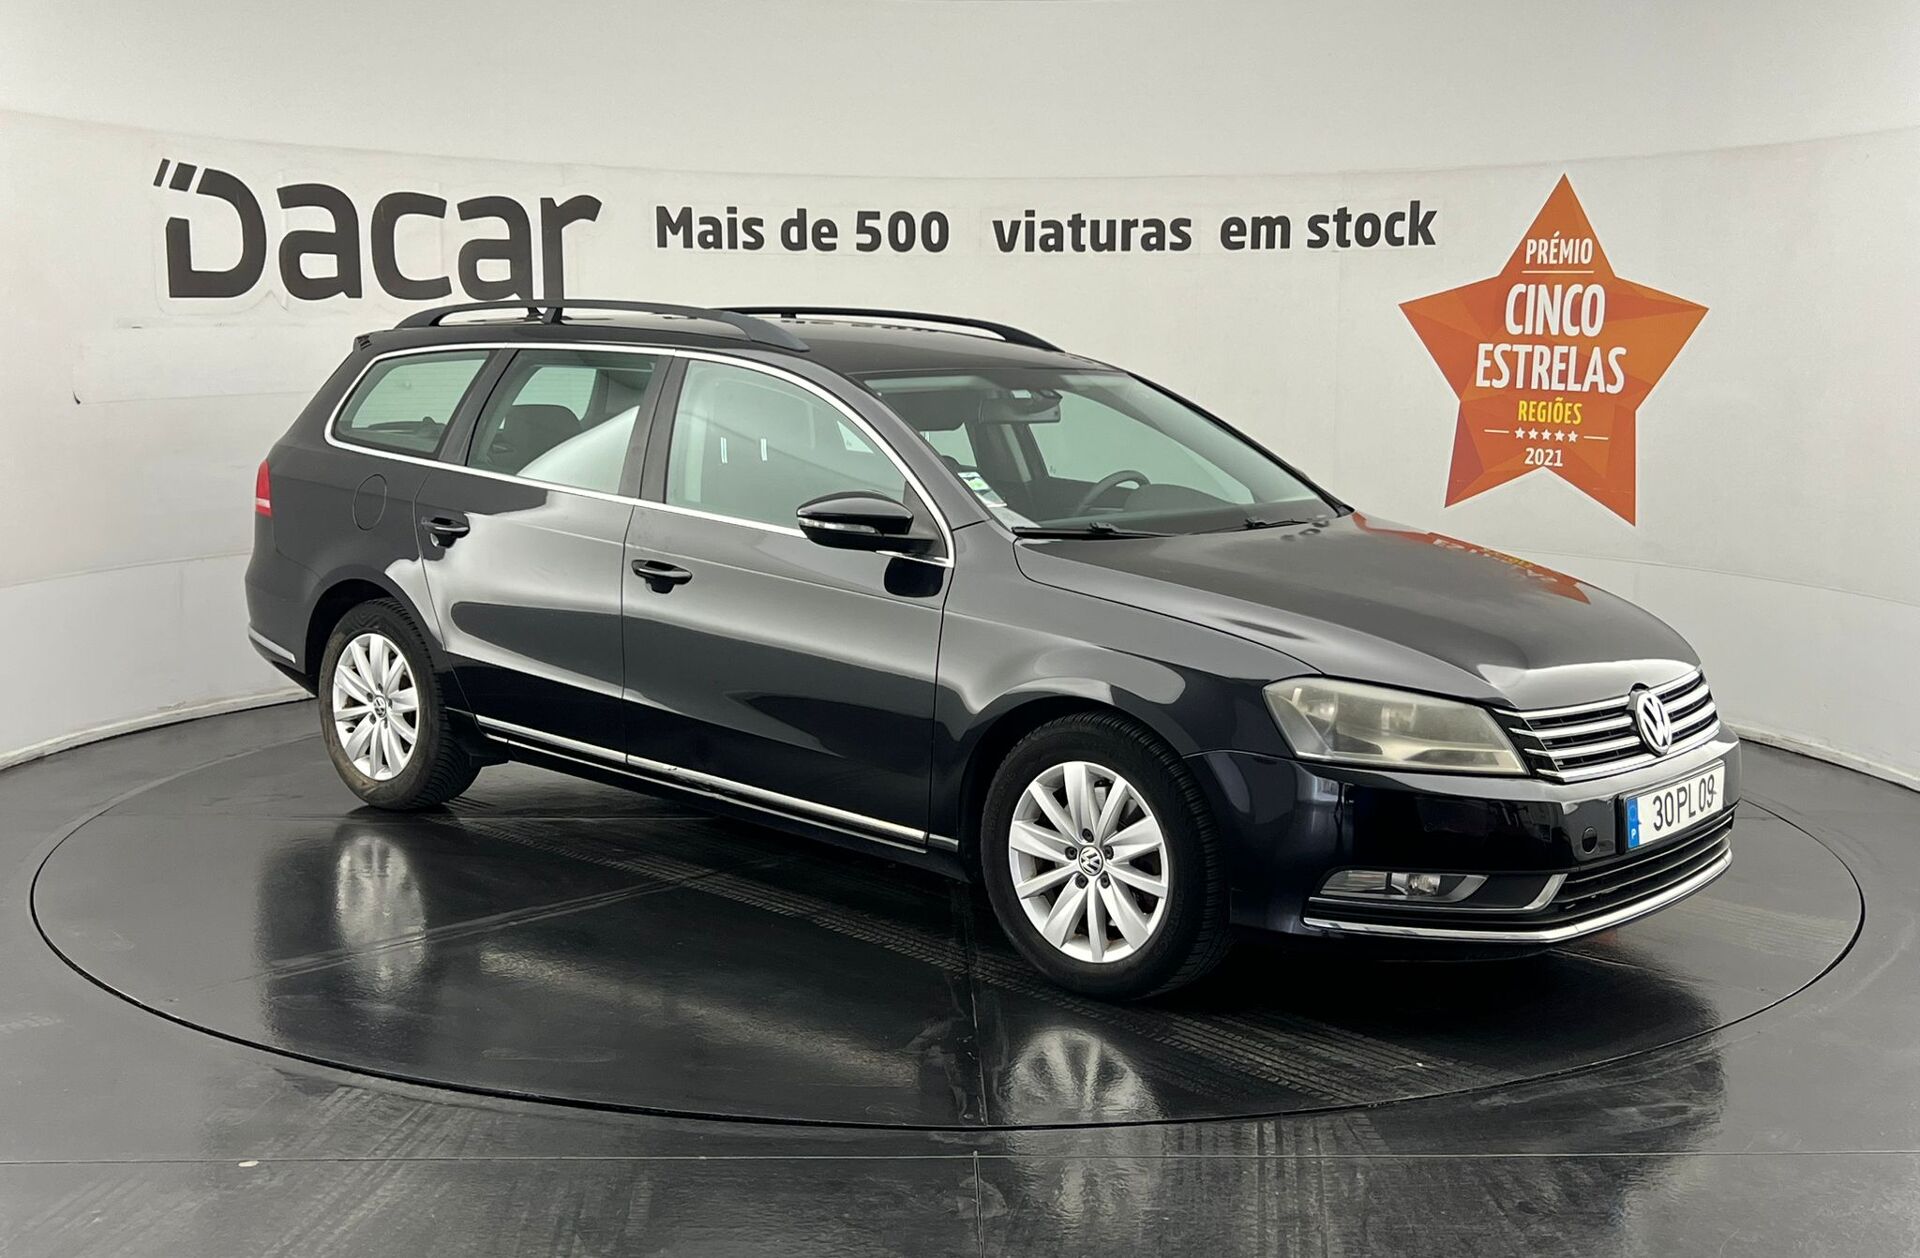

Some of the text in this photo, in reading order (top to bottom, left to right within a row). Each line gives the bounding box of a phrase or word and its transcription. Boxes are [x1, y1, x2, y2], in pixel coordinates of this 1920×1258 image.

[153, 158, 602, 301] Dacar
[656, 199, 1438, 253] Mais de 500 viaturas em stock
[1525, 230, 1594, 265] PRÉMIO
[1505, 283, 1606, 338] CINCO
[1475, 342, 1628, 395] ESTRELAS
[1517, 396, 1583, 426] REGIÕES
[1524, 447, 1564, 468] 2021
